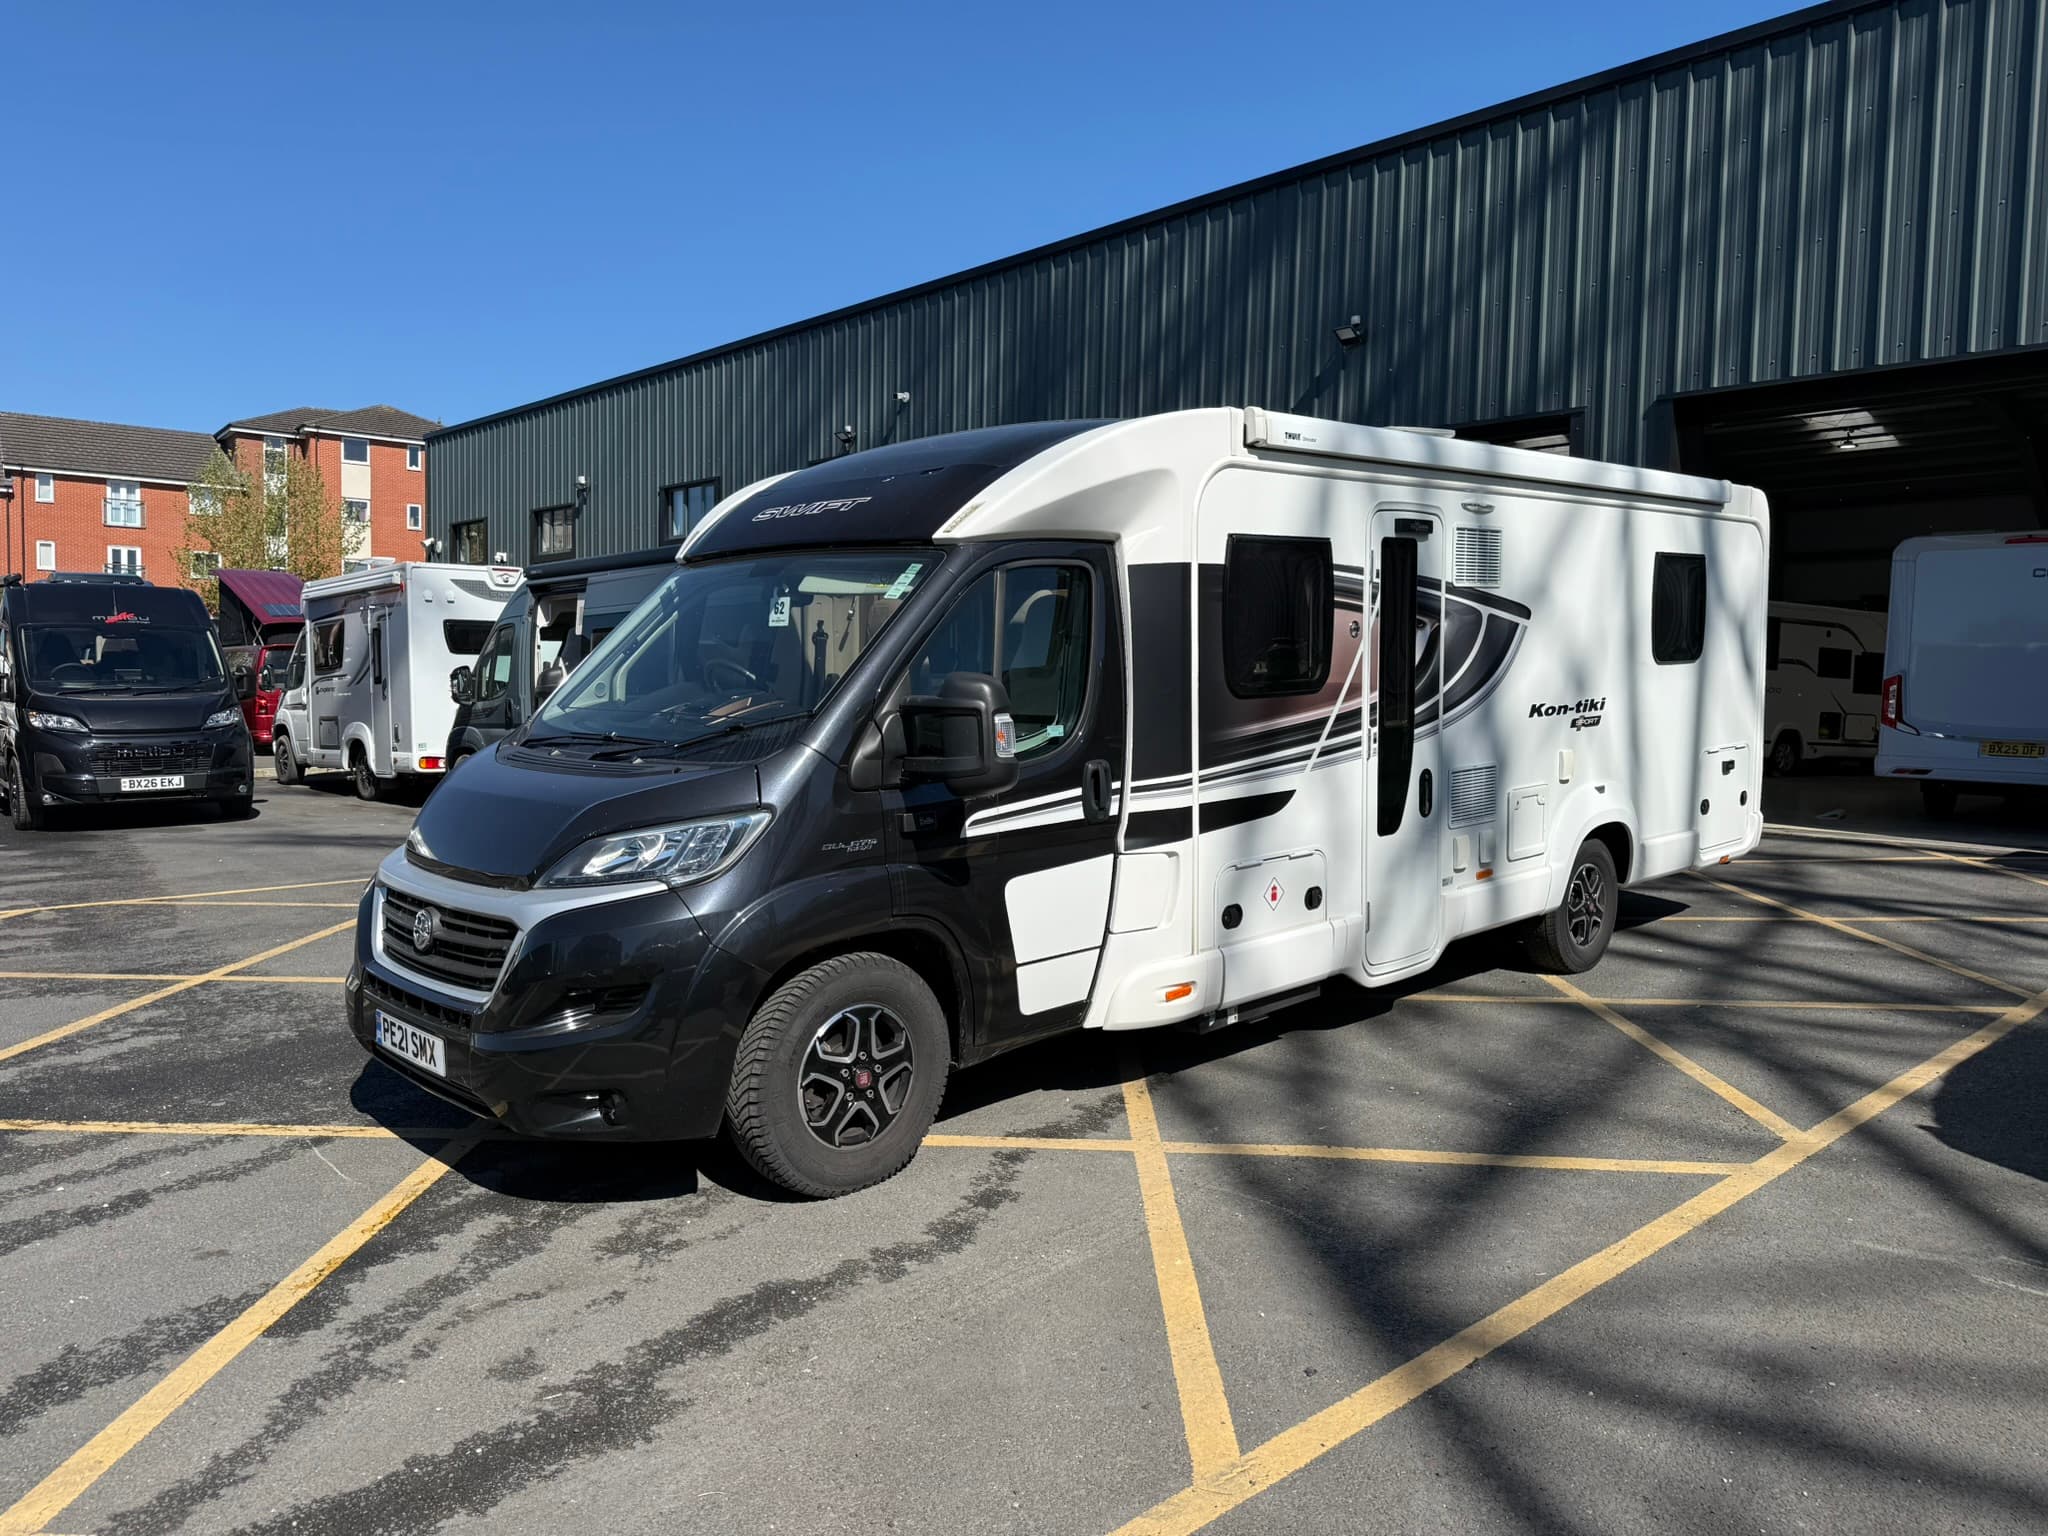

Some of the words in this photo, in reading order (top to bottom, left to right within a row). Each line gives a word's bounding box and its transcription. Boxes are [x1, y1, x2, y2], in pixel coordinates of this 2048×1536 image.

[752, 496, 873, 522] SWIFT
[2032, 567, 2048, 578] C
[774, 601, 785, 615] 62
[1528, 697, 1606, 718] Kon-tiki
[1575, 717, 1599, 727] SPORT
[1988, 744, 2018, 754] BX25
[128, 778, 158, 789] BX26
[160, 776, 182, 788] EKJ
[382, 1017, 409, 1054] PE21
[410, 1031, 437, 1068] SMX
